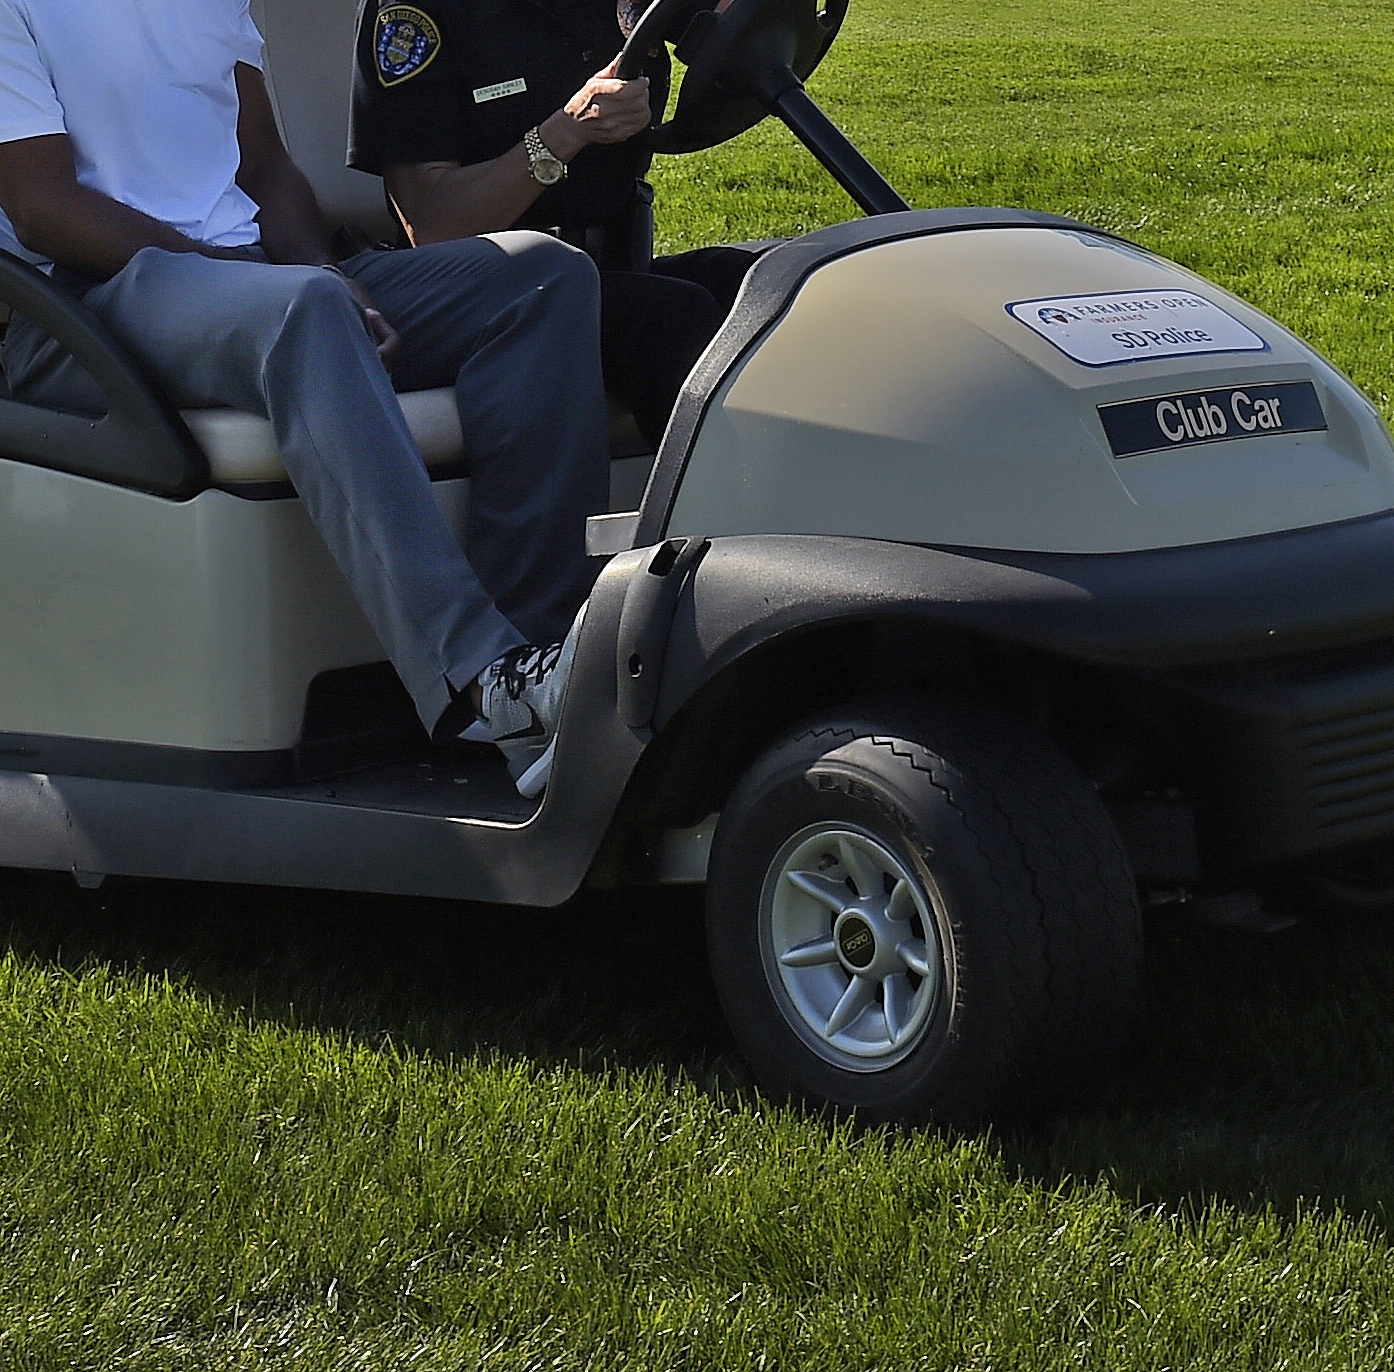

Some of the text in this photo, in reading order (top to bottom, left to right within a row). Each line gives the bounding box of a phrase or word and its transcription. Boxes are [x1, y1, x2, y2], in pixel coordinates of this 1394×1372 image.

[1073, 298, 1209, 317] FARMERS OPEN
[1091, 313, 1148, 324] INSURANCE
[1111, 326, 1213, 349] SD Police
[1156, 391, 1282, 442] Club Car
